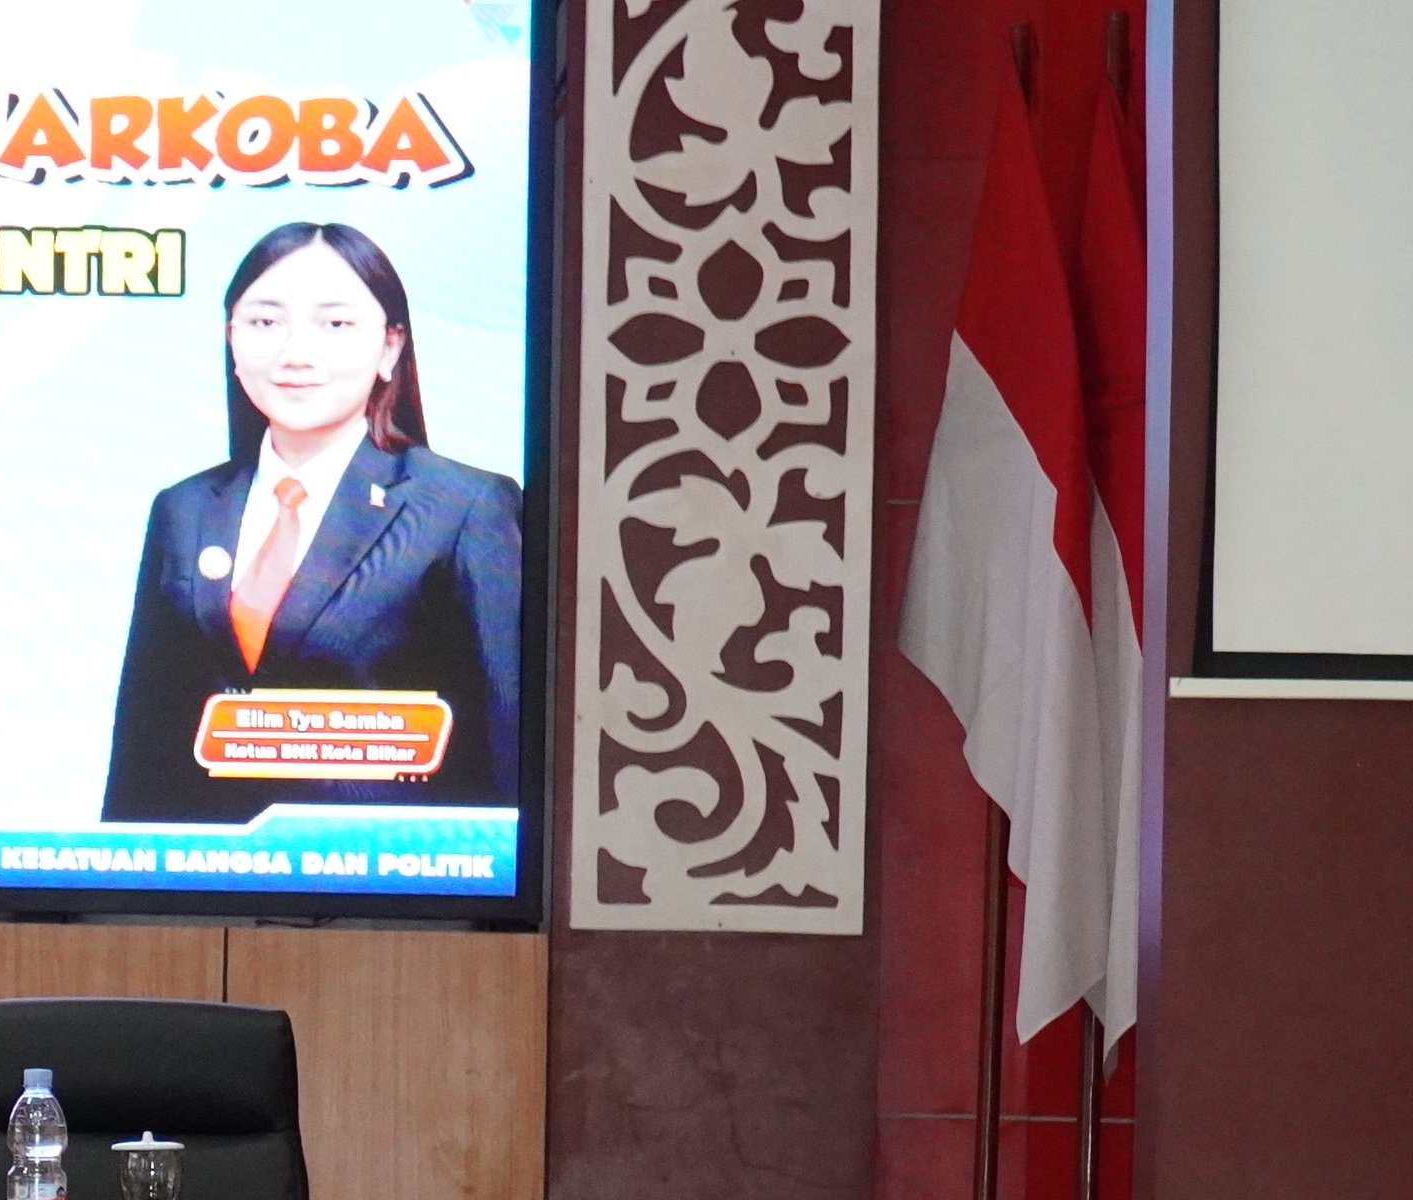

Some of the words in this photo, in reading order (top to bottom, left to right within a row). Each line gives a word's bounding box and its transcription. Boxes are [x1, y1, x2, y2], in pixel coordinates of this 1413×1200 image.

[328, 710, 405, 730] Samba
[224, 742, 277, 759] Ketua
[321, 744, 363, 761] Kota
[0, 846, 157, 872] KESATUAN
[301, 851, 369, 876] DAN
[377, 853, 495, 878] POLITIK
